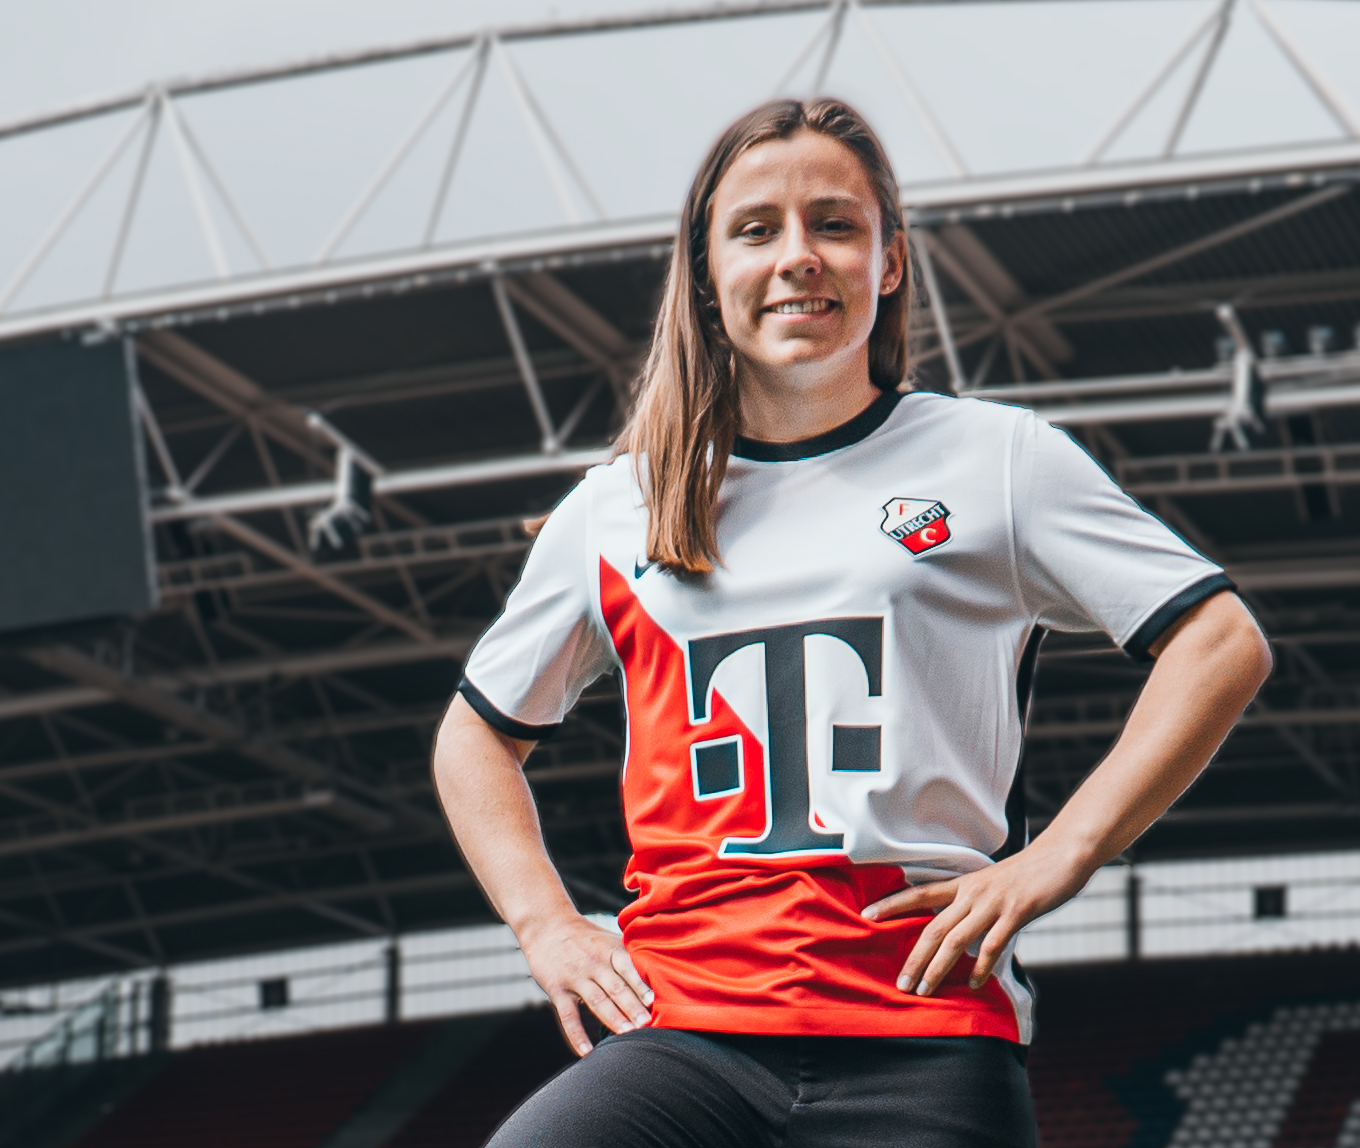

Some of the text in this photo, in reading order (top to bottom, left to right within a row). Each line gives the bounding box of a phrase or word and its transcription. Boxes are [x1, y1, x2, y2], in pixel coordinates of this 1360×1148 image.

[889, 503, 946, 540] UTRECHT
[899, 503, 910, 516] F
[920, 527, 937, 544] C
[687, 616, 885, 856] T
